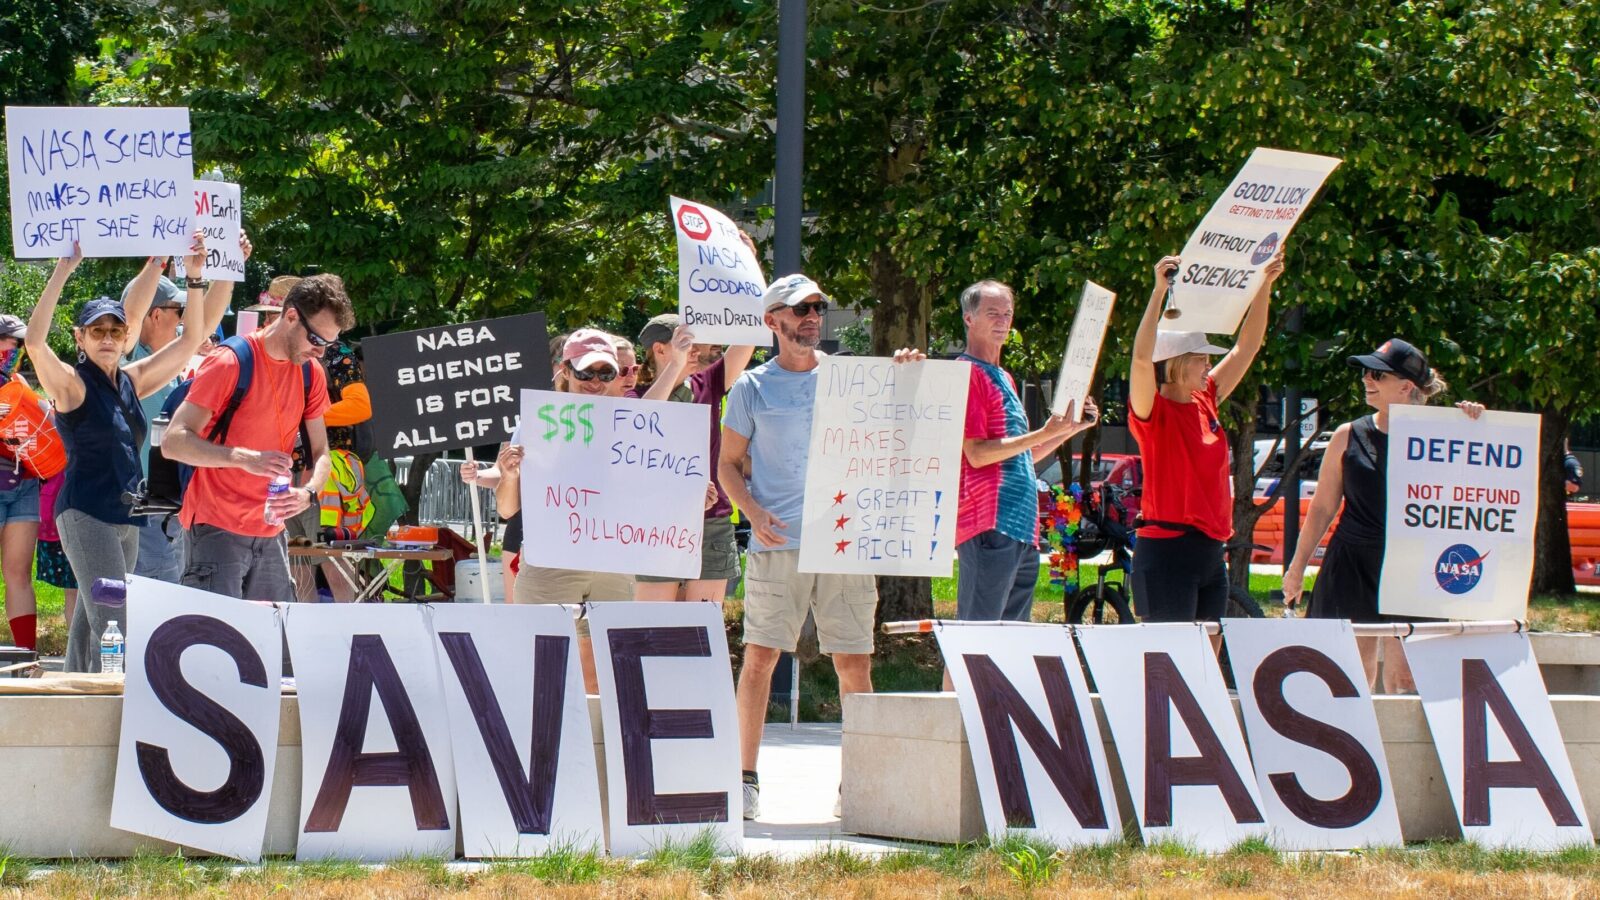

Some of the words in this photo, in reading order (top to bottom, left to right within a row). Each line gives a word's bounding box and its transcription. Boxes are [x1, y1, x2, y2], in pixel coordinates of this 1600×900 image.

[22, 129, 100, 176] NASA
[104, 128, 192, 163] SCIENCE
[27, 182, 90, 217] MAKES
[99, 178, 177, 207] AMERICA
[1233, 182, 1276, 204] GOOD
[1273, 186, 1310, 205] LUCK
[211, 194, 239, 220] Earth
[1229, 204, 1263, 218] GETTING
[1264, 209, 1273, 219] TO
[1272, 207, 1299, 220] MARS
[22, 218, 86, 247] GREAT
[96, 214, 139, 238] SAFE
[152, 215, 188, 240] RICH
[203, 227, 225, 240] ence
[683, 214, 704, 228] STOP
[1199, 231, 1256, 254] WITHOUT
[206, 249, 220, 269] ED
[698, 245, 748, 271] NASA
[688, 268, 762, 297] GODDARD
[1182, 263, 1256, 290] SCIENCE
[684, 305, 721, 326] BRAIN
[724, 308, 762, 327] DRAIN
[416, 326, 496, 352] NASA
[397, 352, 522, 385] SCIENCE
[828, 363, 896, 397] NASA
[416, 395, 444, 415] IS
[454, 385, 514, 408] FOR
[852, 401, 953, 423] SCIENCE
[393, 426, 448, 449] ALL
[455, 418, 492, 440] OF
[503, 414, 520, 434] U
[537, 403, 594, 448] $$$
[613, 409, 664, 437] FOR
[823, 427, 906, 455] MAKES
[1407, 436, 1522, 469] DEFEND
[611, 441, 703, 477] SCIENCE
[846, 457, 940, 478] AMERICA
[545, 484, 600, 508] NOT
[856, 488, 928, 510] GREAT
[1407, 483, 1443, 500] NOT
[1453, 486, 1520, 505] DEFUND
[861, 515, 916, 532] SAFE
[1404, 503, 1517, 533] SCIENCE
[568, 512, 700, 557] BILLIONAIRES!
[858, 537, 912, 560] RICH
[1438, 562, 1480, 576] NASA
[136, 613, 729, 834] SAVE
[962, 645, 1581, 829] NASA
